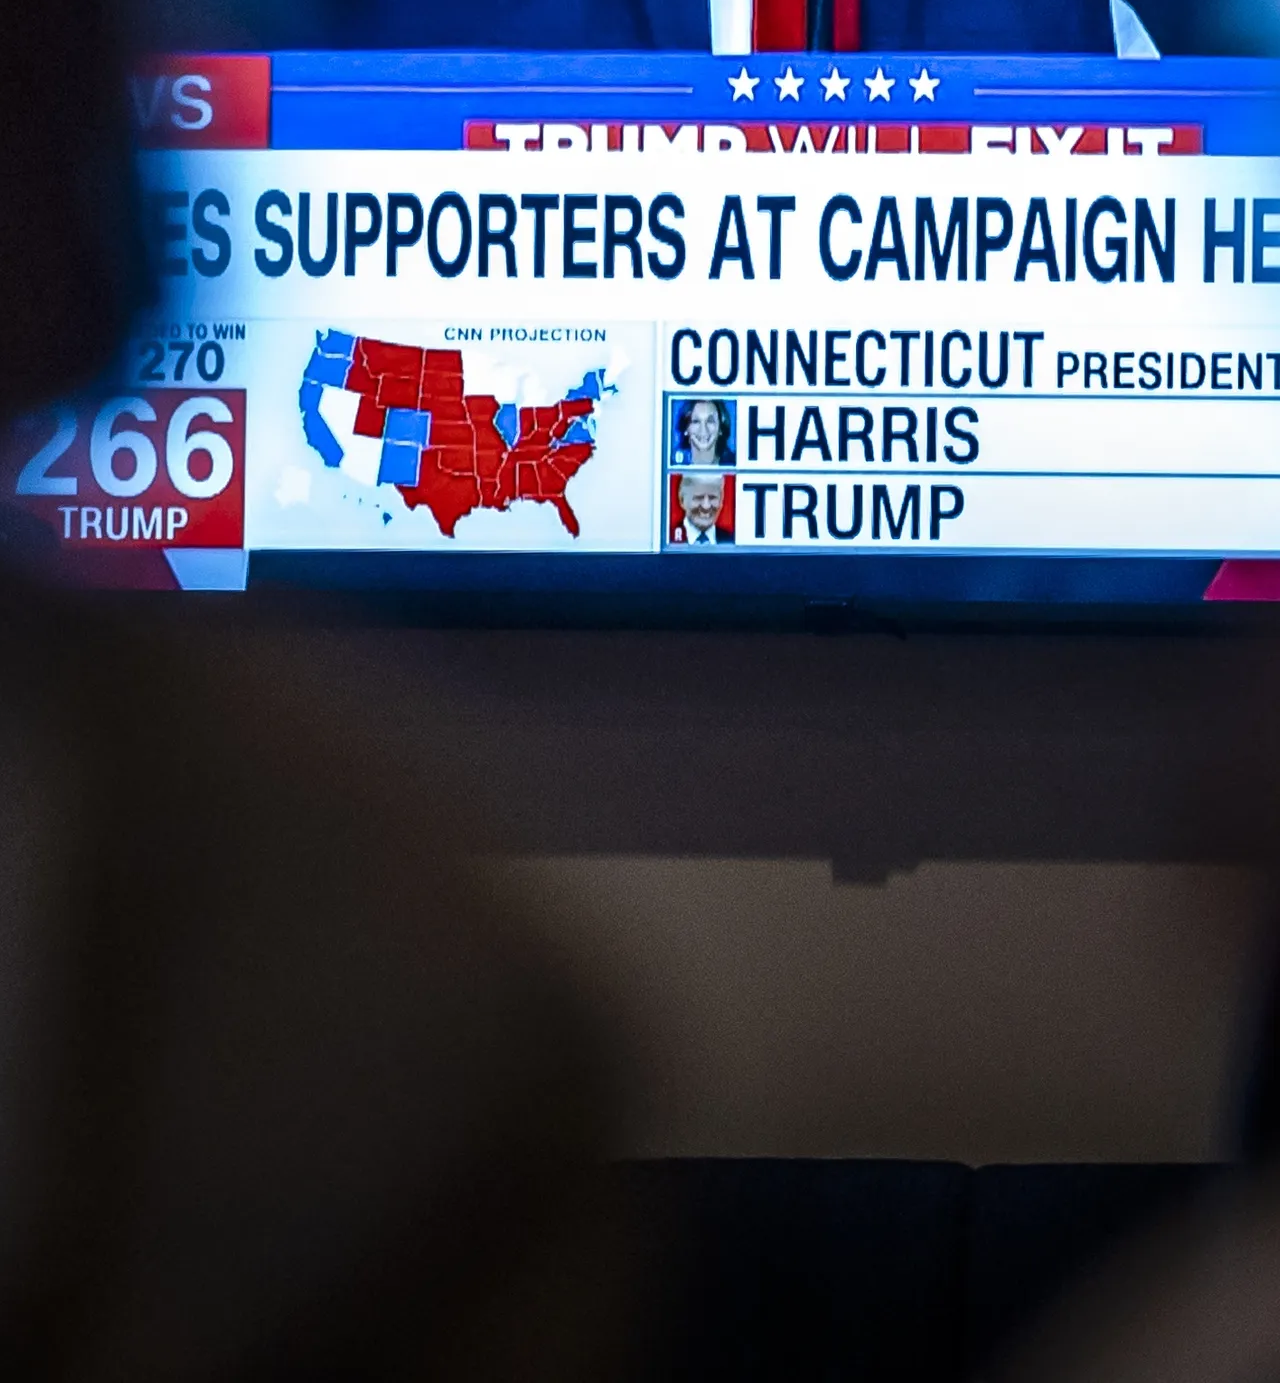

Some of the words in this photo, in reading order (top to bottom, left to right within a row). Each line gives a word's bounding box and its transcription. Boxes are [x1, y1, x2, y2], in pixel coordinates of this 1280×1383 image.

[254, 189, 686, 281] SUPPORTERS
[708, 195, 796, 280] AT
[818, 194, 1176, 284] CAMPAIGN
[137, 340, 226, 383] 270
[212, 323, 246, 340] WIN
[444, 327, 483, 341] CNN
[490, 327, 607, 342] PROJECTION
[671, 328, 1045, 389] CONNECTICUT
[15, 395, 235, 500] 266
[747, 405, 981, 466] HARRIS
[57, 505, 190, 541] TRUMP
[742, 483, 966, 543] TRUMP
